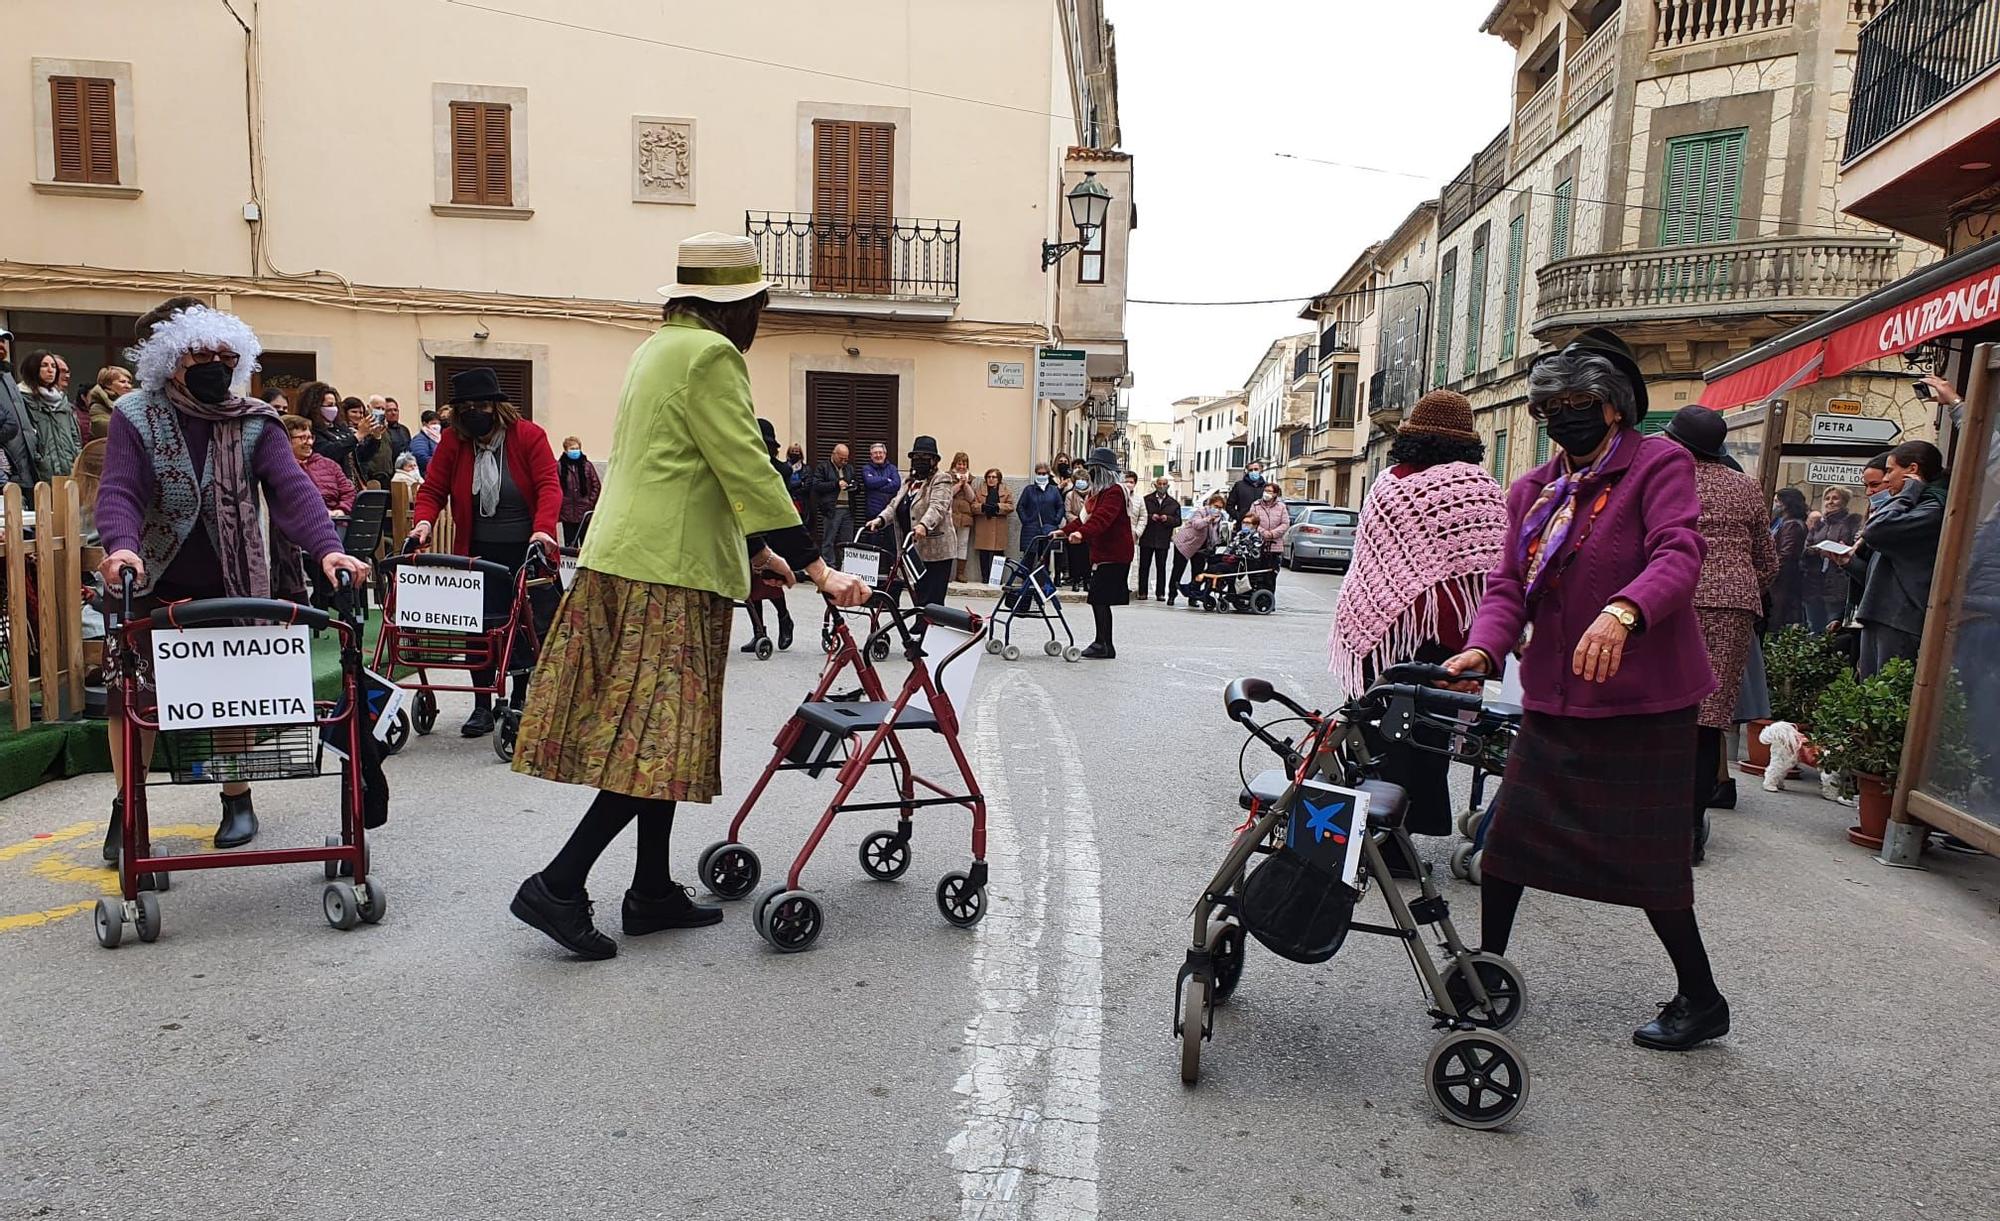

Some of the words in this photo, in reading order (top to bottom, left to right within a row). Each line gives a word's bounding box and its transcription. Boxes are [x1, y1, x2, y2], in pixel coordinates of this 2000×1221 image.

[1879, 307, 1919, 350] CAN
[1918, 275, 2000, 337] TRONCA
[1818, 421, 1853, 432] PETRA
[1811, 473, 1845, 482] POLICIA
[1812, 464, 1864, 474] AJUNTAMEN
[400, 573, 431, 586] SOM
[434, 575, 480, 590] MAJOR
[401, 610, 421, 622] NO
[425, 612, 478, 628] BENEITA
[158, 640, 214, 660] SOM
[223, 637, 305, 657] MAJOR
[168, 702, 204, 721] NO
[212, 698, 306, 718] BENEITA
